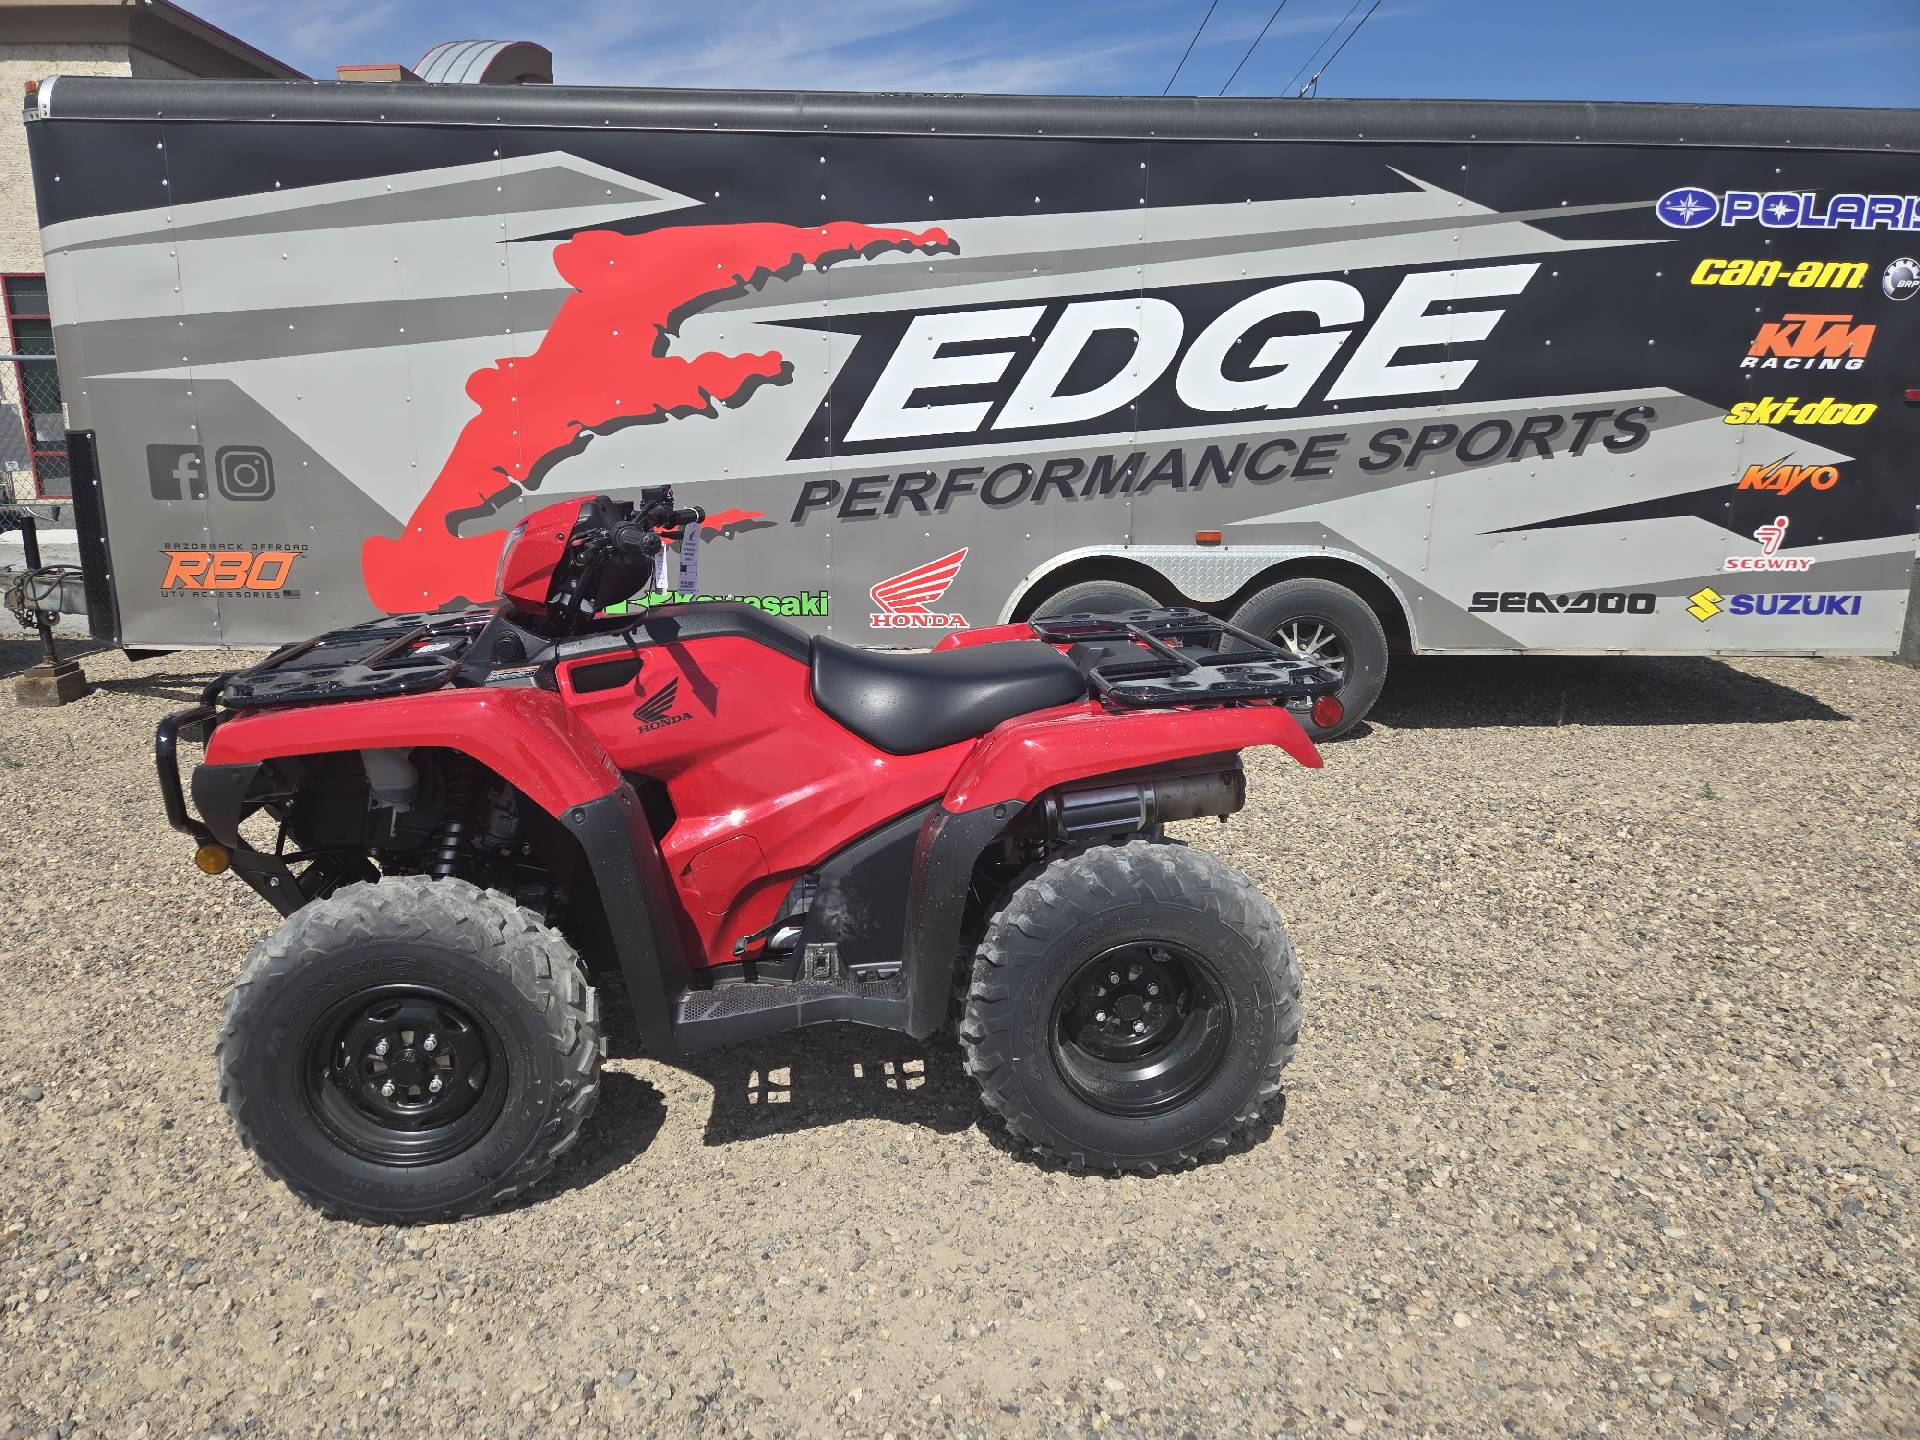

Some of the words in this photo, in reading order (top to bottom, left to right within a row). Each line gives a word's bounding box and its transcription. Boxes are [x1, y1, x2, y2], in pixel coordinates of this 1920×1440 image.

[1721, 191, 1920, 231] POLARI
[1747, 313, 1877, 357] KTM
[842, 263, 1541, 442] EDGE
[1739, 357, 1865, 370] RACING
[1723, 397, 1878, 425] ski-doo
[789, 432, 1347, 525] PERFORMANCE
[1358, 406, 1656, 475] SPORTS
[1737, 450, 1839, 496] KAYO
[251, 543, 309, 551] OFFROAD
[159, 551, 303, 590] RBO
[1726, 558, 1813, 569] SEGWAY
[1729, 593, 1862, 616] SUZUKI
[870, 613, 970, 628] HONDA
[638, 712, 693, 734] HONDA
